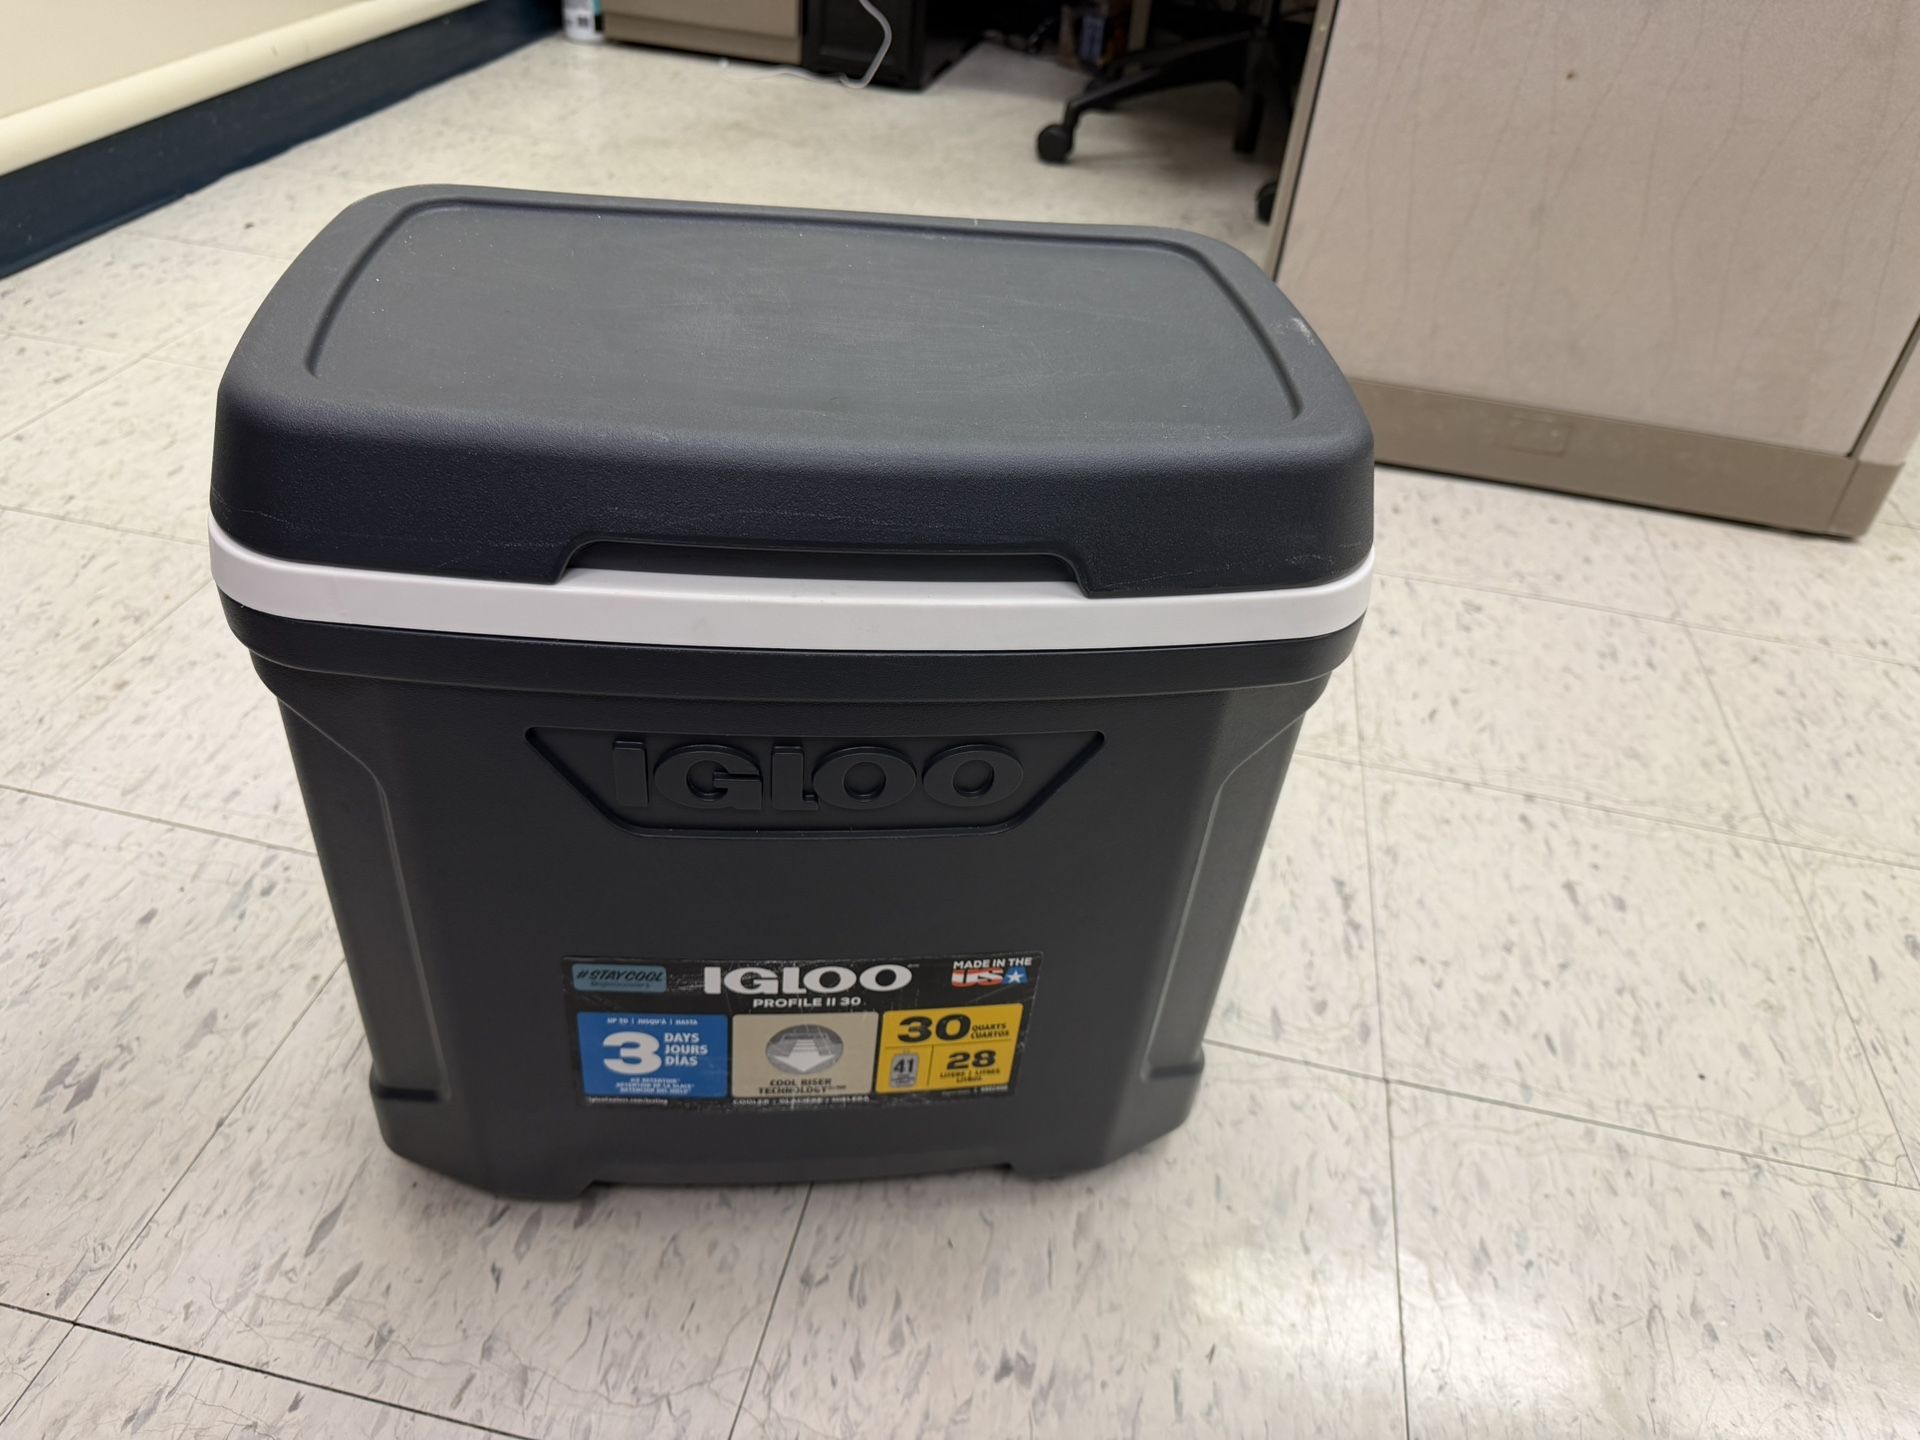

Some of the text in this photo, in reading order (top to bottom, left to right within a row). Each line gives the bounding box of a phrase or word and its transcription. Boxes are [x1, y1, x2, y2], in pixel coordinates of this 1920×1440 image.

[612, 741, 1024, 811] IGLOO
[952, 957, 1033, 969] MADE IN THE
[575, 969, 664, 982] #STAYCOOL
[704, 964, 913, 995] IGLOO
[753, 998, 822, 1008] PROFILE
[840, 997, 862, 1007] 30
[898, 1014, 972, 1043] 30
[972, 1023, 1007, 1032] QUARTS
[664, 1032, 700, 1043] DAYS
[602, 1031, 662, 1075] 3
[665, 1044, 708, 1055] JOURS
[665, 1054, 699, 1066] DÍAS
[893, 1058, 915, 1073] 41
[946, 1050, 996, 1070] 28
